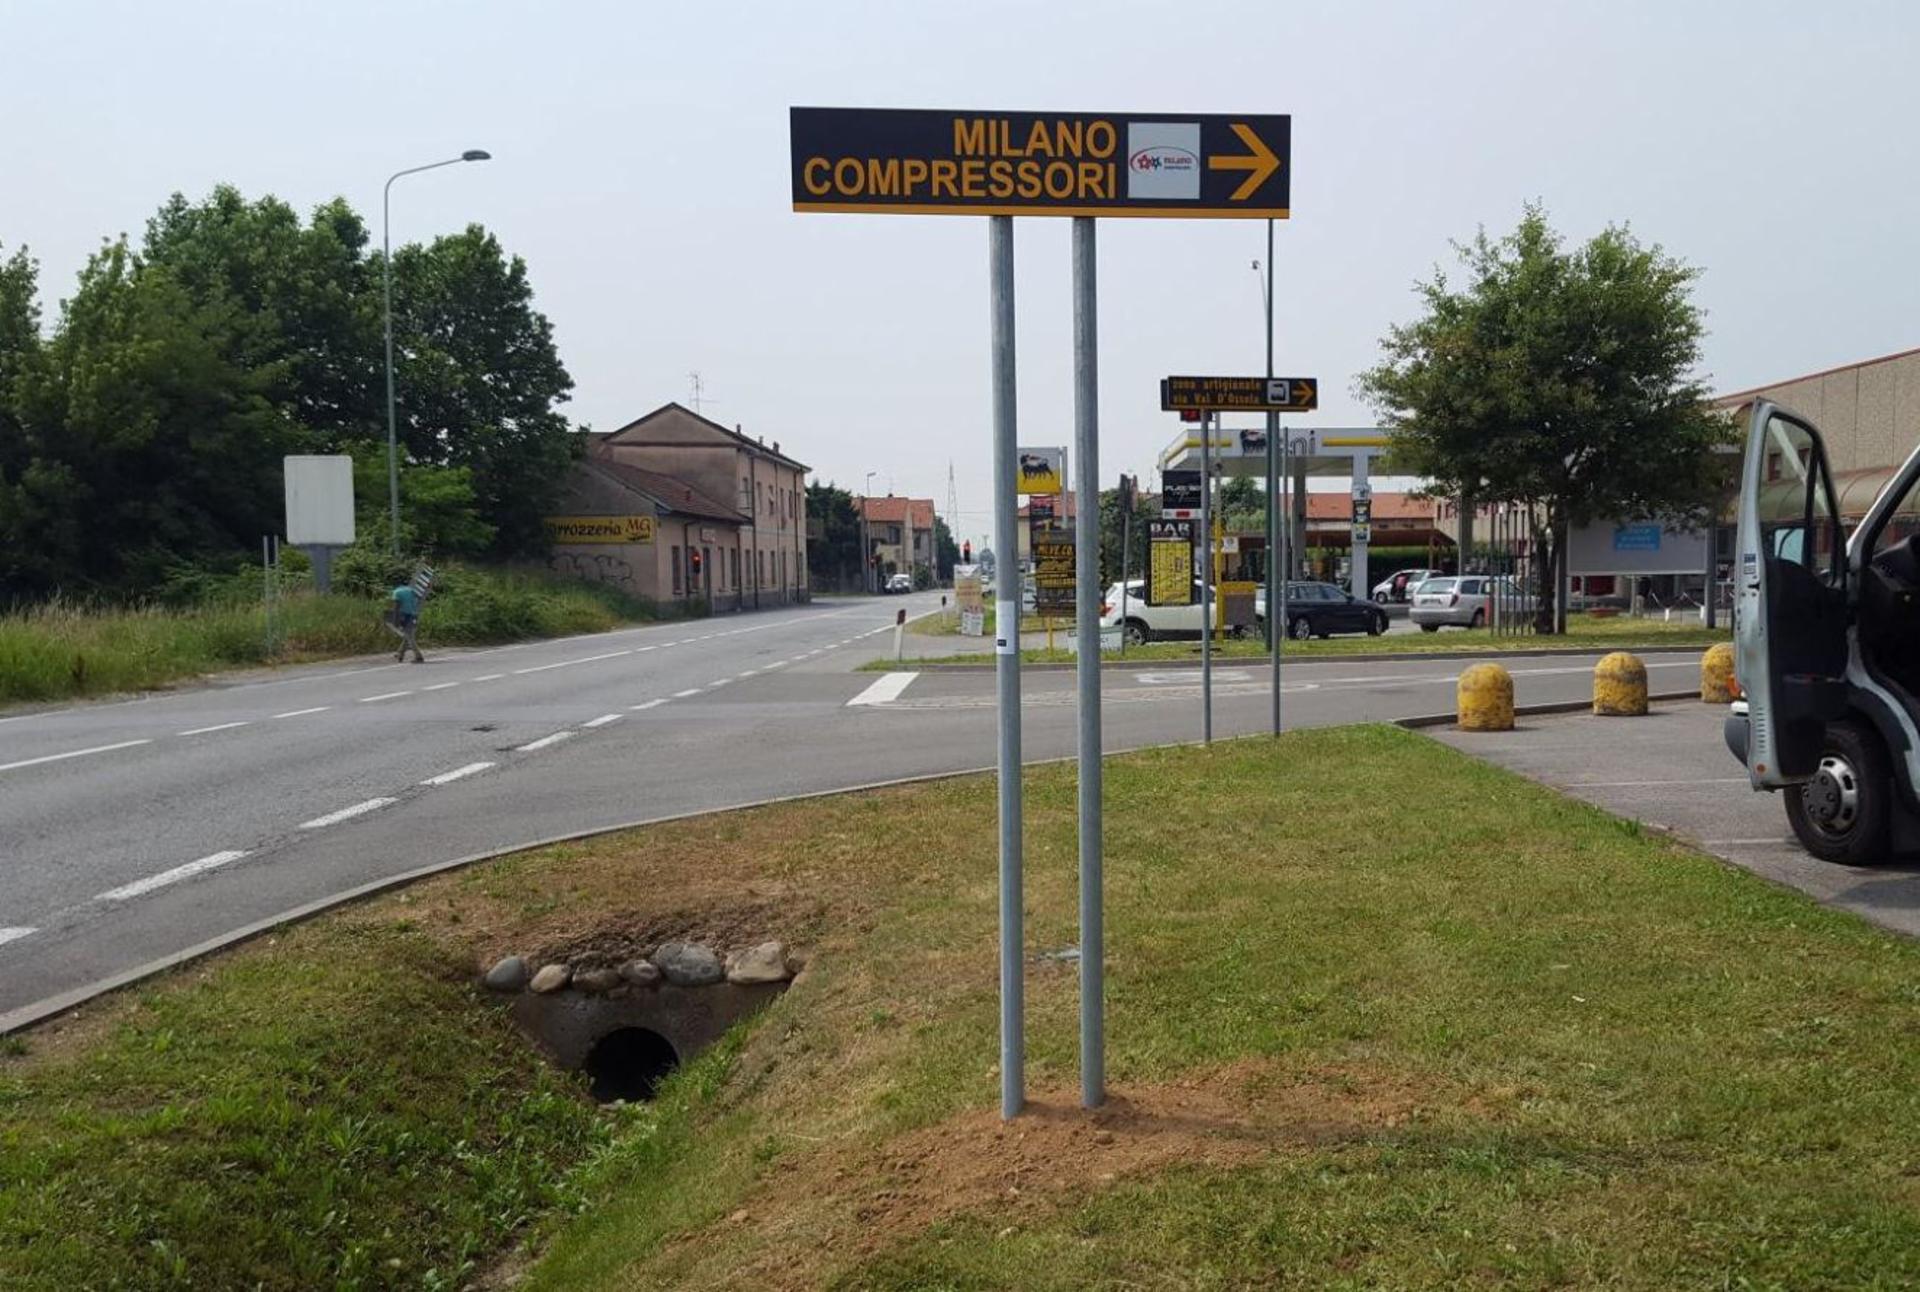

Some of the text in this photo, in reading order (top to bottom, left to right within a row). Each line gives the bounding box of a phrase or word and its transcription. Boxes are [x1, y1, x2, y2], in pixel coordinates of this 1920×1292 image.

[953, 117, 1117, 159] MILANO
[803, 157, 1116, 200] COMPRESSORI
[1149, 522, 1190, 532] BAR
